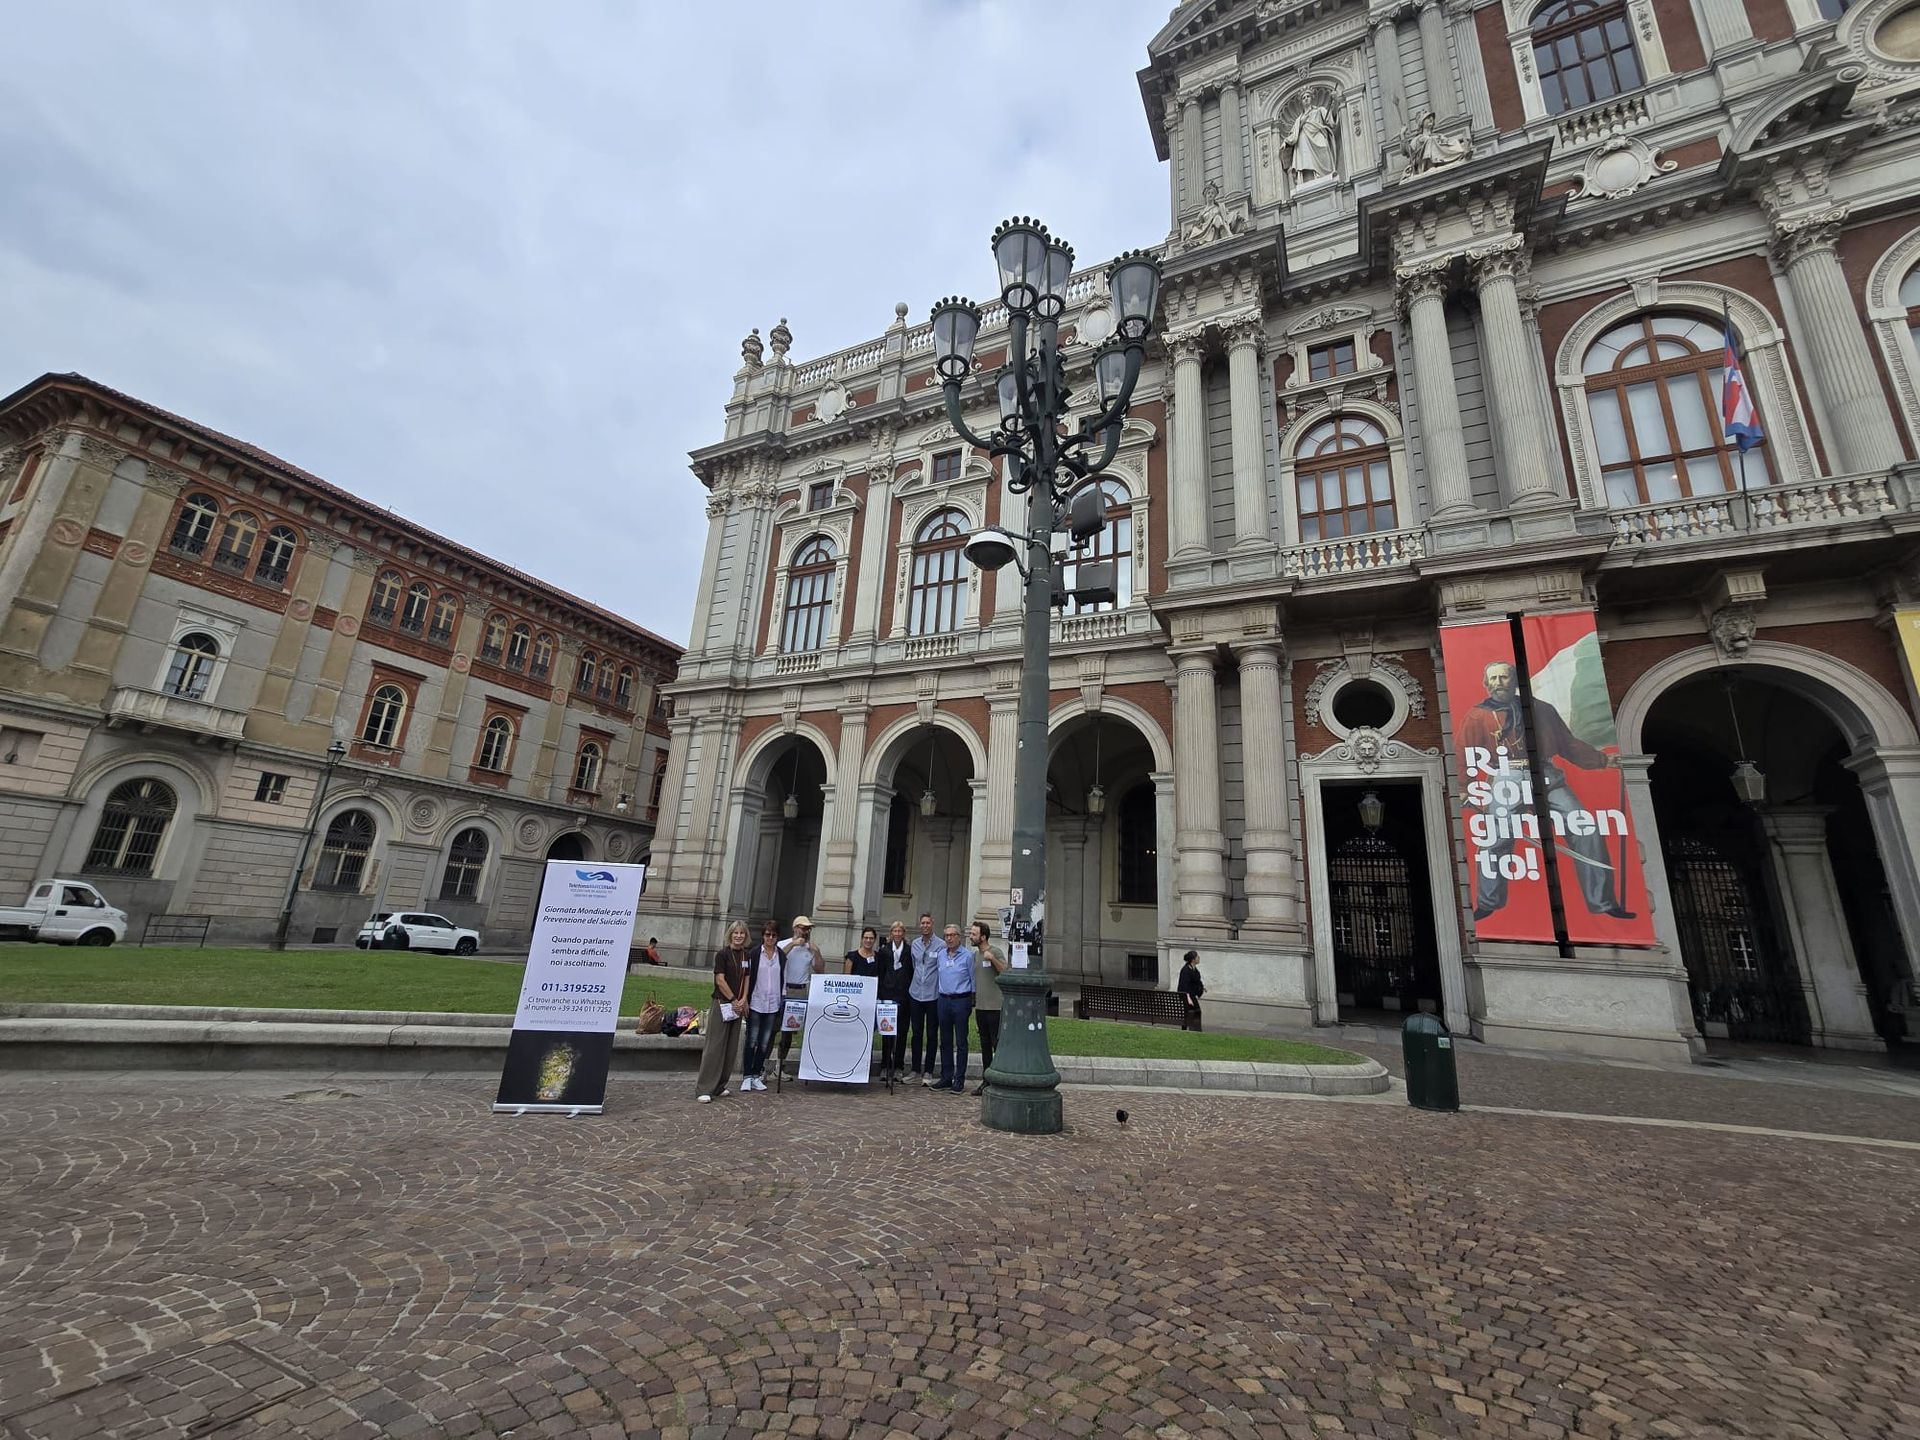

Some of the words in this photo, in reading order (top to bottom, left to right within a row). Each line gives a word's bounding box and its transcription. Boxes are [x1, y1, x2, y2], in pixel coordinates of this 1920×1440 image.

[1465, 745, 1510, 777] Ri
[1474, 847, 1541, 881] to!
[544, 905, 577, 914] Giornata
[577, 907, 611, 916] Mondiale
[542, 915, 587, 924] Prevenzione
[587, 917, 598, 925] del
[599, 917, 628, 926] Suicidio
[551, 935, 582, 944] Quando
[582, 936, 615, 946] parlarne
[551, 948, 580, 956] sembra
[580, 949, 610, 957] difficile,
[563, 960, 607, 968] ascoltiamo.
[541, 982, 606, 994] 011.3195252
[823, 980, 864, 989] SALVADANAIO
[834, 987, 863, 995] BENESSERE
[551, 997, 571, 1005] anche
[580, 998, 612, 1007] Whatsapp
